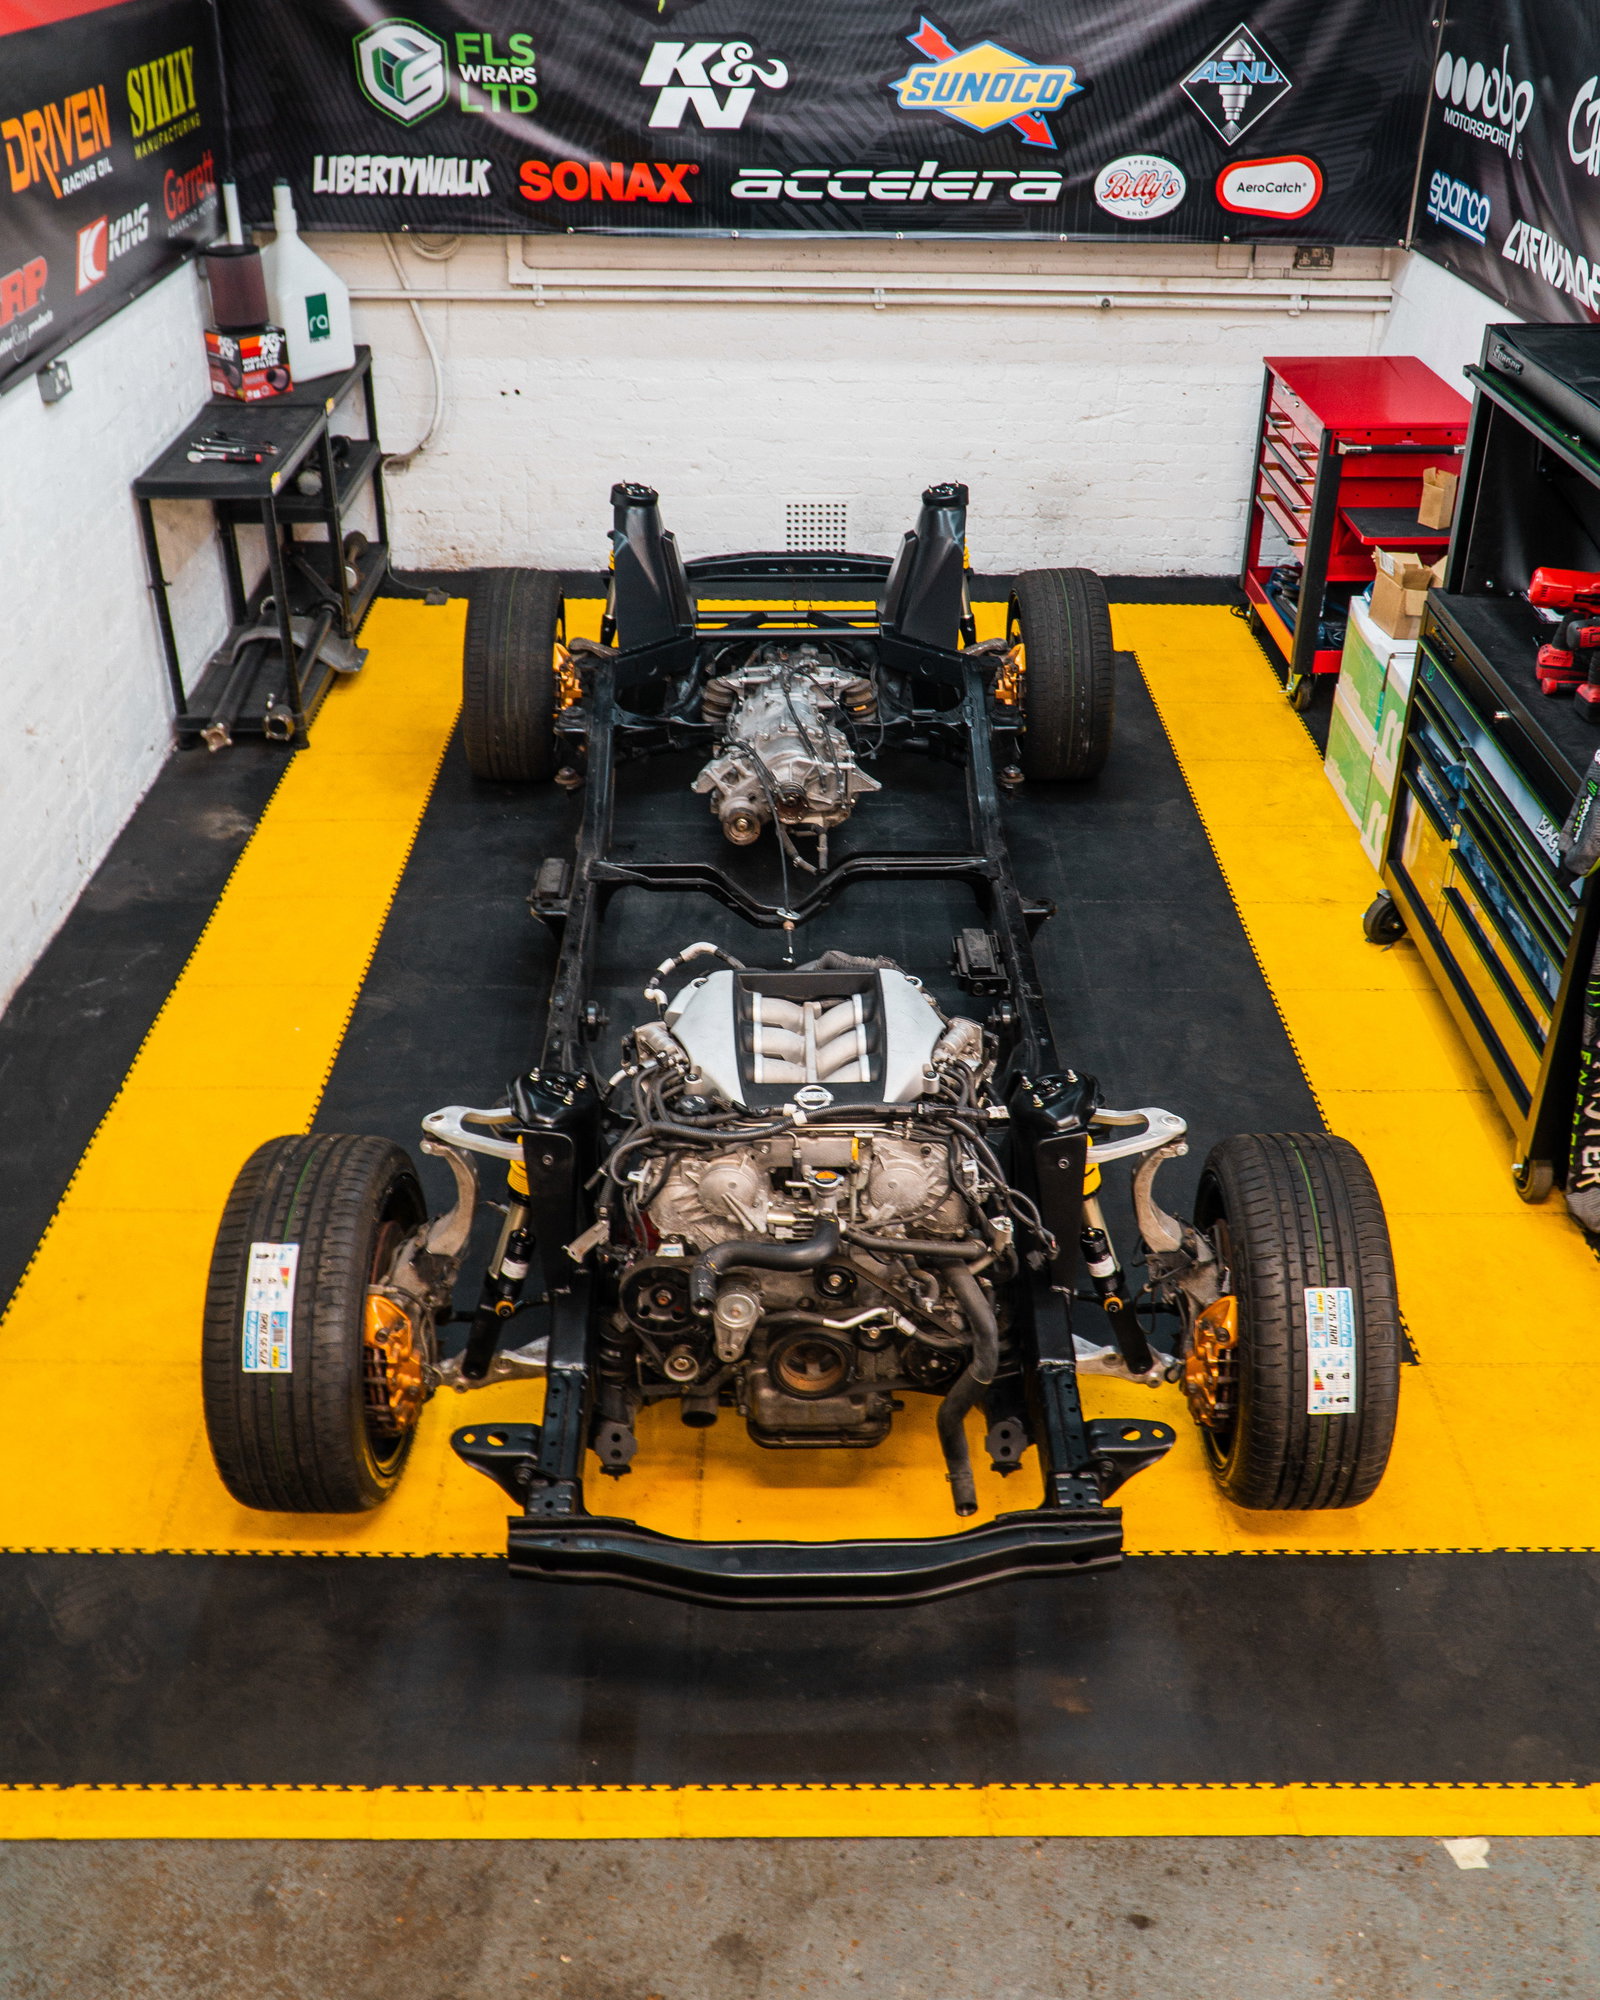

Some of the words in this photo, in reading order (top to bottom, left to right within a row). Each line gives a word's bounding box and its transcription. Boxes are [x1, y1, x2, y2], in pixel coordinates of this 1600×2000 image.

[455, 32, 536, 67] FLS
[127, 46, 196, 138] SIKKY
[458, 64, 537, 85] WRAPS
[640, 41, 789, 129] K&N
[906, 72, 1067, 103] SUNOCO
[460, 83, 538, 113] LTD
[1, 84, 112, 199] DRIVEN
[134, 113, 201, 160] MANUFACTURING
[1444, 107, 1510, 149] MOTORSPORT
[62, 164, 96, 196] RACING
[97, 157, 113, 177] OIL
[164, 149, 216, 220] Garrett
[313, 155, 491, 197] LIBERTYWALK
[731, 161, 1063, 200] accelera
[1102, 171, 1178, 206] Billy's
[1430, 172, 1490, 232] sparco
[109, 202, 148, 262] KING
